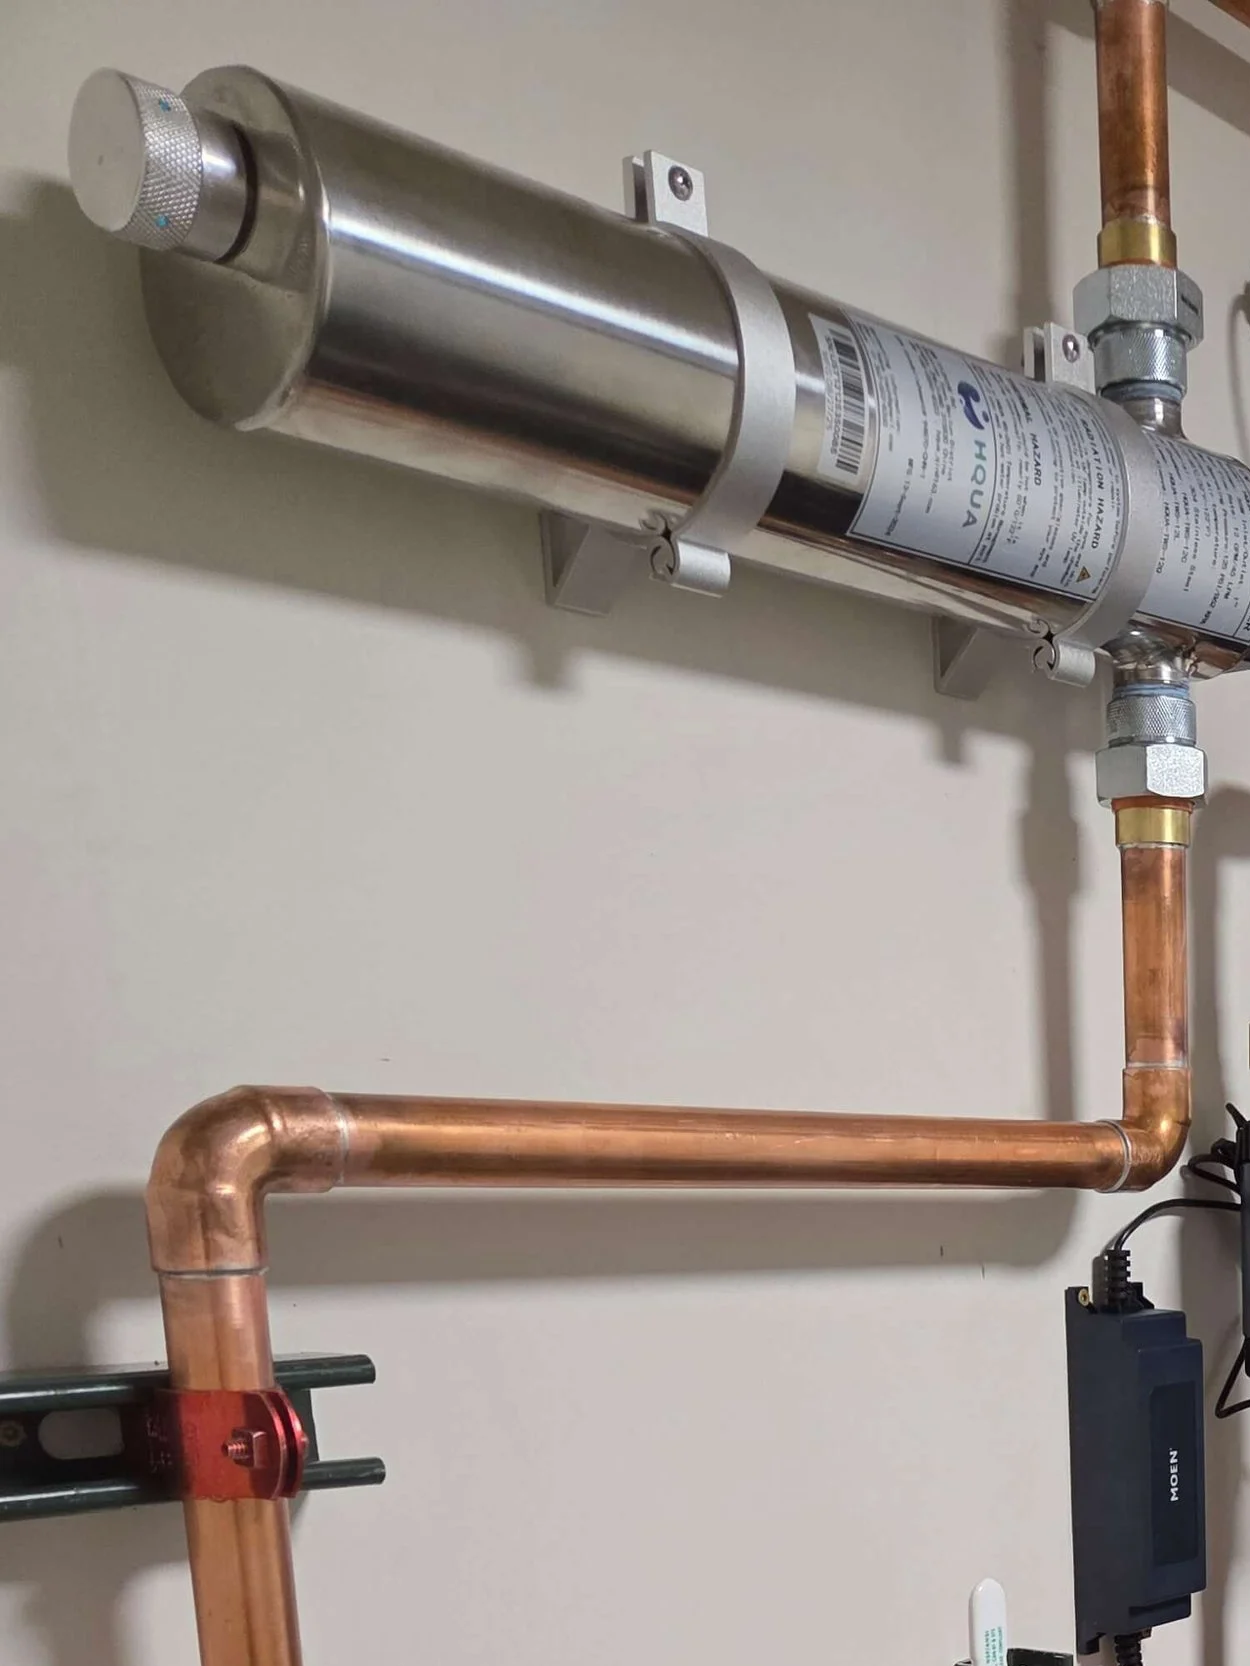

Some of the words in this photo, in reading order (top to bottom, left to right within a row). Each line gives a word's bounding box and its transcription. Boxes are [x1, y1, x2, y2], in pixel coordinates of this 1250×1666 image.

[958, 437, 987, 531] HQUA
[1028, 431, 1042, 487] HAZARD
[1089, 496, 1105, 551] HAZARD
[1169, 1450, 1179, 1502] MOEN
